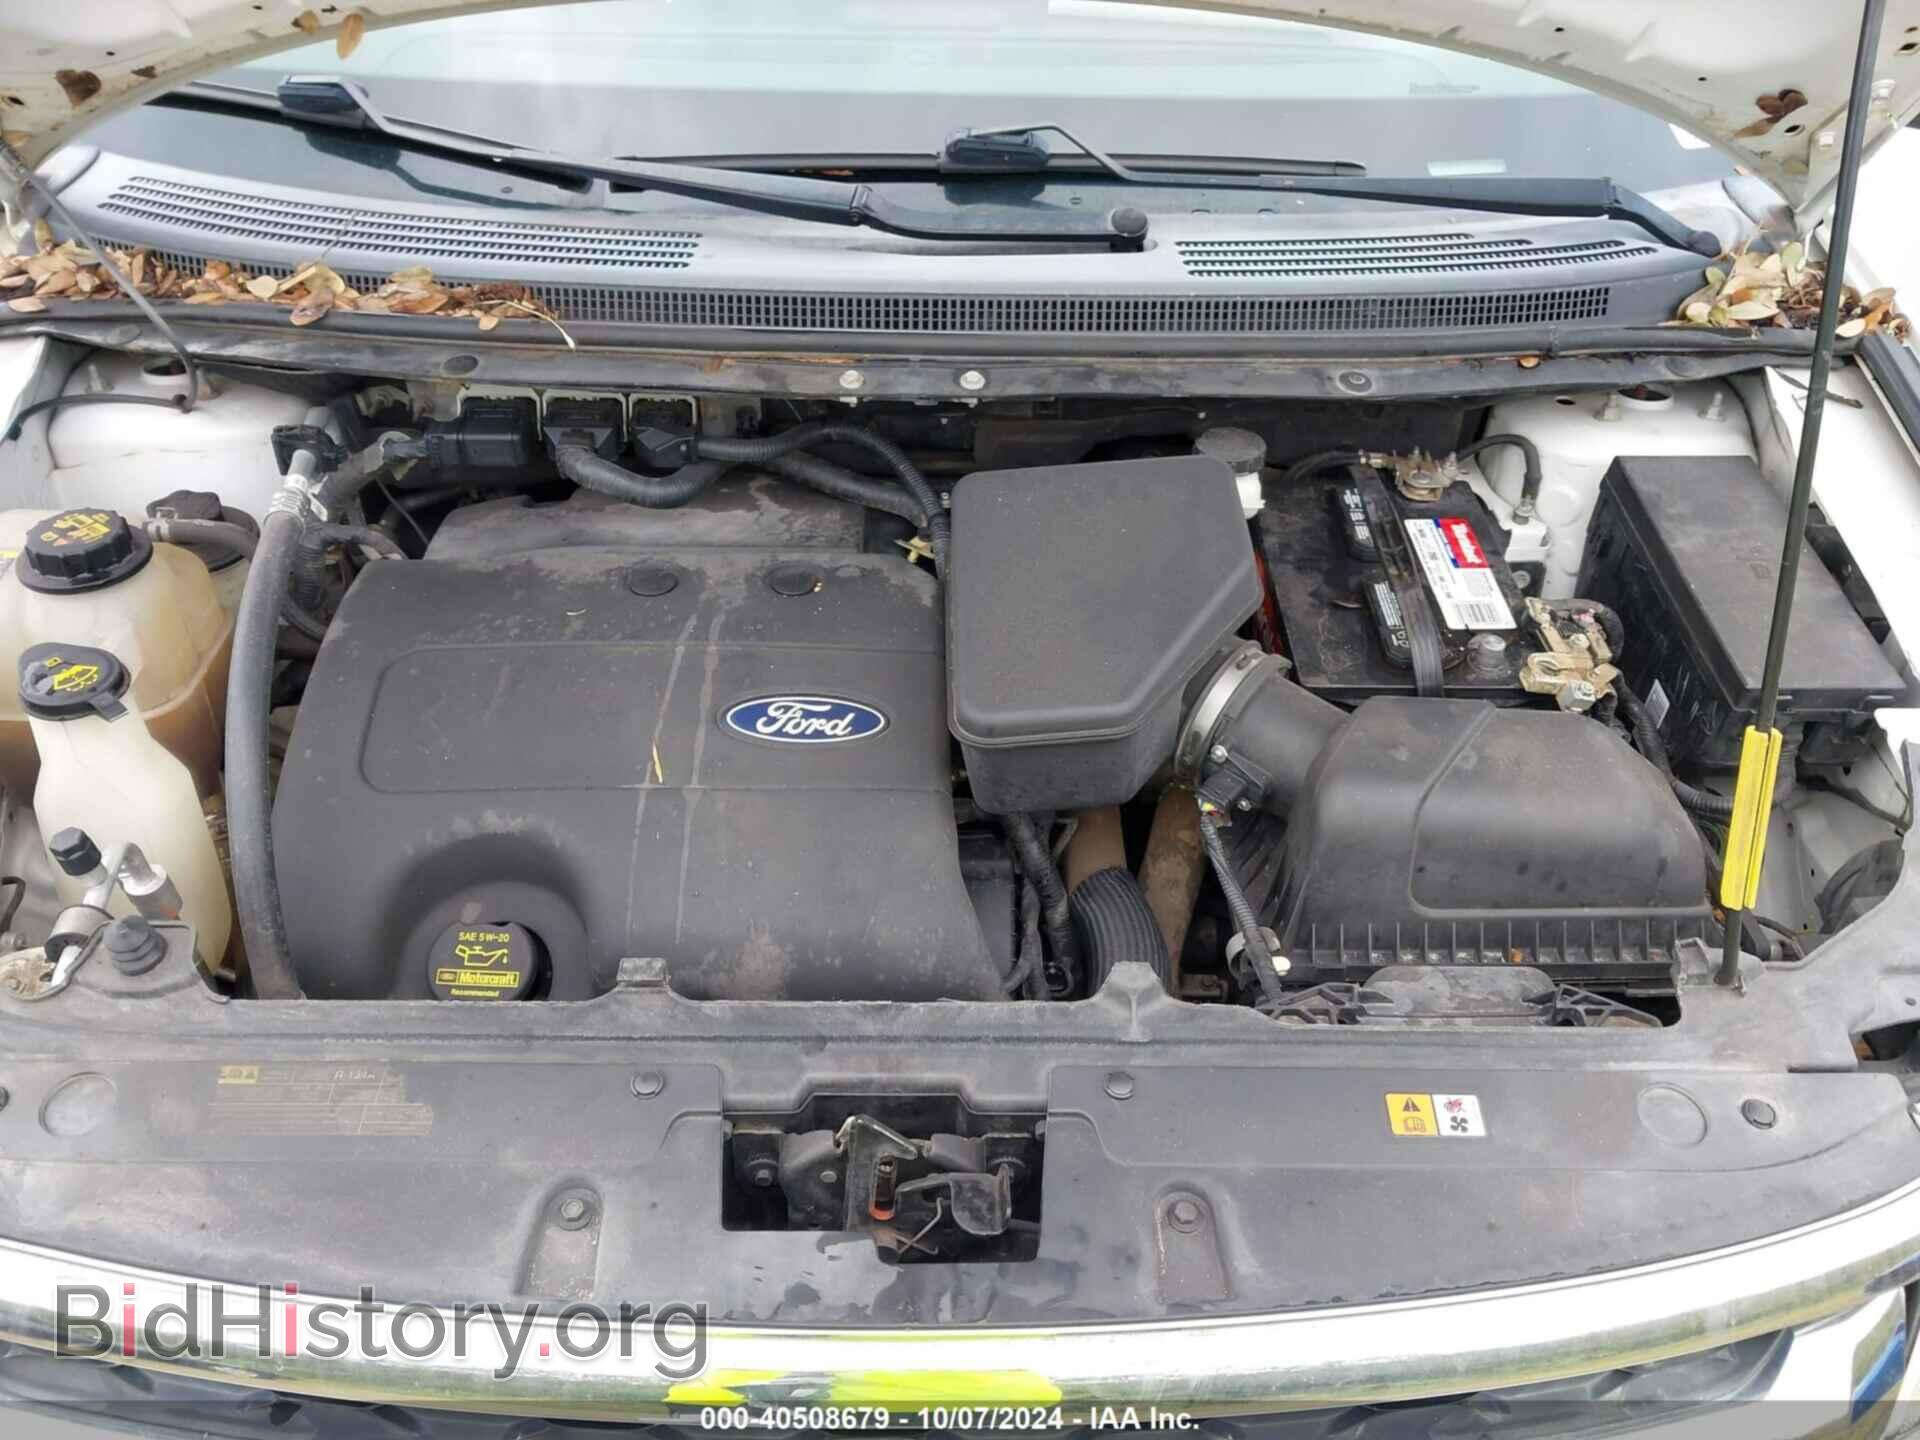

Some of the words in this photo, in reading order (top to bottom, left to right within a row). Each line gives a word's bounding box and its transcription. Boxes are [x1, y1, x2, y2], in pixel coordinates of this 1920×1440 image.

[756, 702, 855, 736] Ford
[459, 932, 478, 941] SAE
[460, 972, 516, 986] Motorcraft
